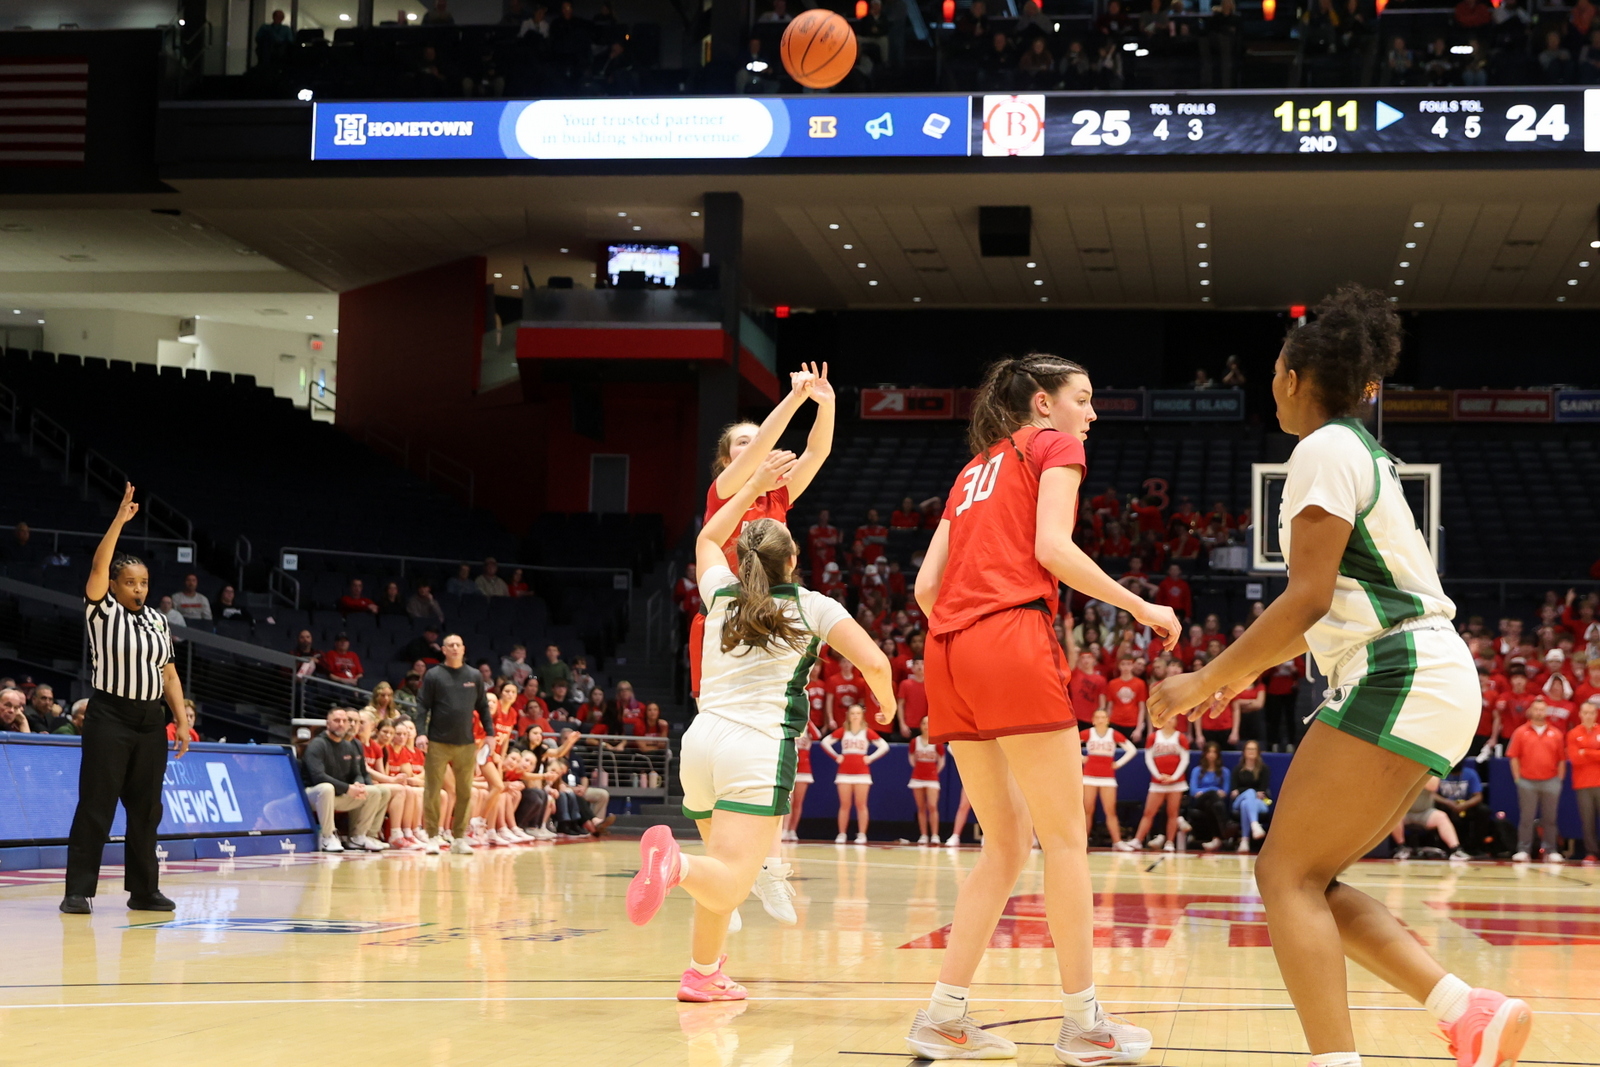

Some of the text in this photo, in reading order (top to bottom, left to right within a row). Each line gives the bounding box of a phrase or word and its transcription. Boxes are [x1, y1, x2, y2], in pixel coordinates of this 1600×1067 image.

[1150, 103, 1216, 115] TOL FOULS
[1274, 100, 1357, 132] 1:11
[1419, 100, 1484, 113] FOULS TOL
[368, 121, 473, 137] HOMETOWN
[563, 113, 726, 127] Your trusted partner
[1006, 111, 1027, 136] B
[1071, 110, 1131, 146] 25
[1153, 118, 1203, 141] 4 3
[1431, 116, 1481, 138] 4 5
[1505, 104, 1569, 141] 24
[542, 132, 557, 144] in
[562, 131, 626, 145] building
[1299, 135, 1337, 152] 2ND
[955, 452, 1005, 517] 30
[165, 789, 220, 823] NEWS
